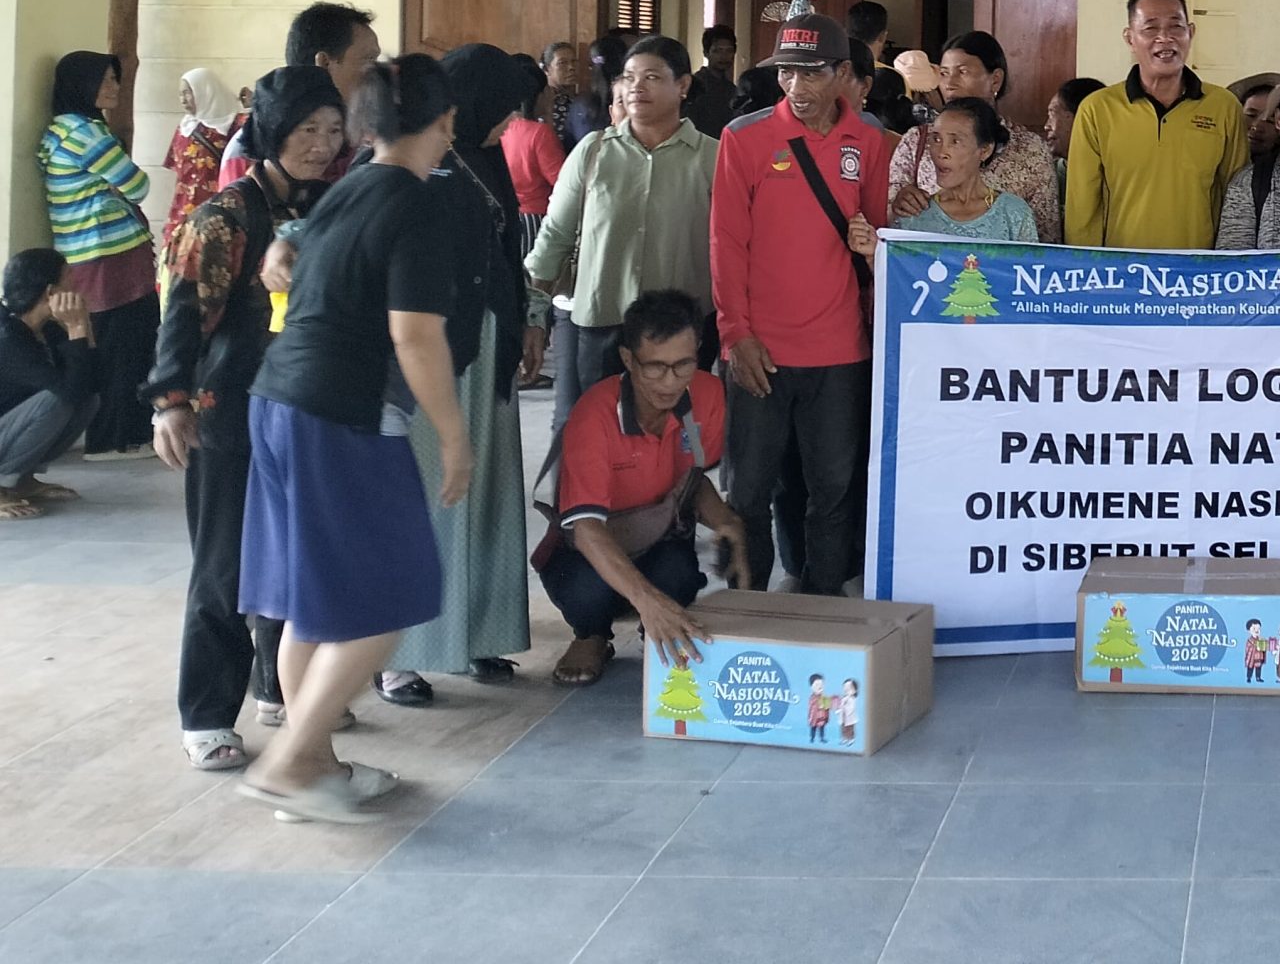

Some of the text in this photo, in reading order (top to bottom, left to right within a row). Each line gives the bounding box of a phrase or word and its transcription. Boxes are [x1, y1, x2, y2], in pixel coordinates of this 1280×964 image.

[780, 28, 820, 43] NKRI
[1012, 264, 1124, 296] NATAL
[1053, 302, 1089, 314] Hadir
[1092, 302, 1131, 315] untuk
[1134, 302, 1236, 317] Menyelamatkan
[940, 367, 1179, 403] BANTUAN
[1001, 431, 1193, 466] PANITIA
[965, 490, 1180, 520] OIKUMENE
[969, 544, 1007, 574] DI
[1175, 604, 1209, 614] PANITIA
[1165, 616, 1217, 632] NATAL
[1146, 629, 1237, 647] NASIONAL
[737, 656, 772, 666] PANITIA
[1171, 646, 1208, 662] 2025
[728, 667, 780, 684] NATAL
[708, 680, 800, 704] NASIONAL
[733, 701, 772, 716] 2025
